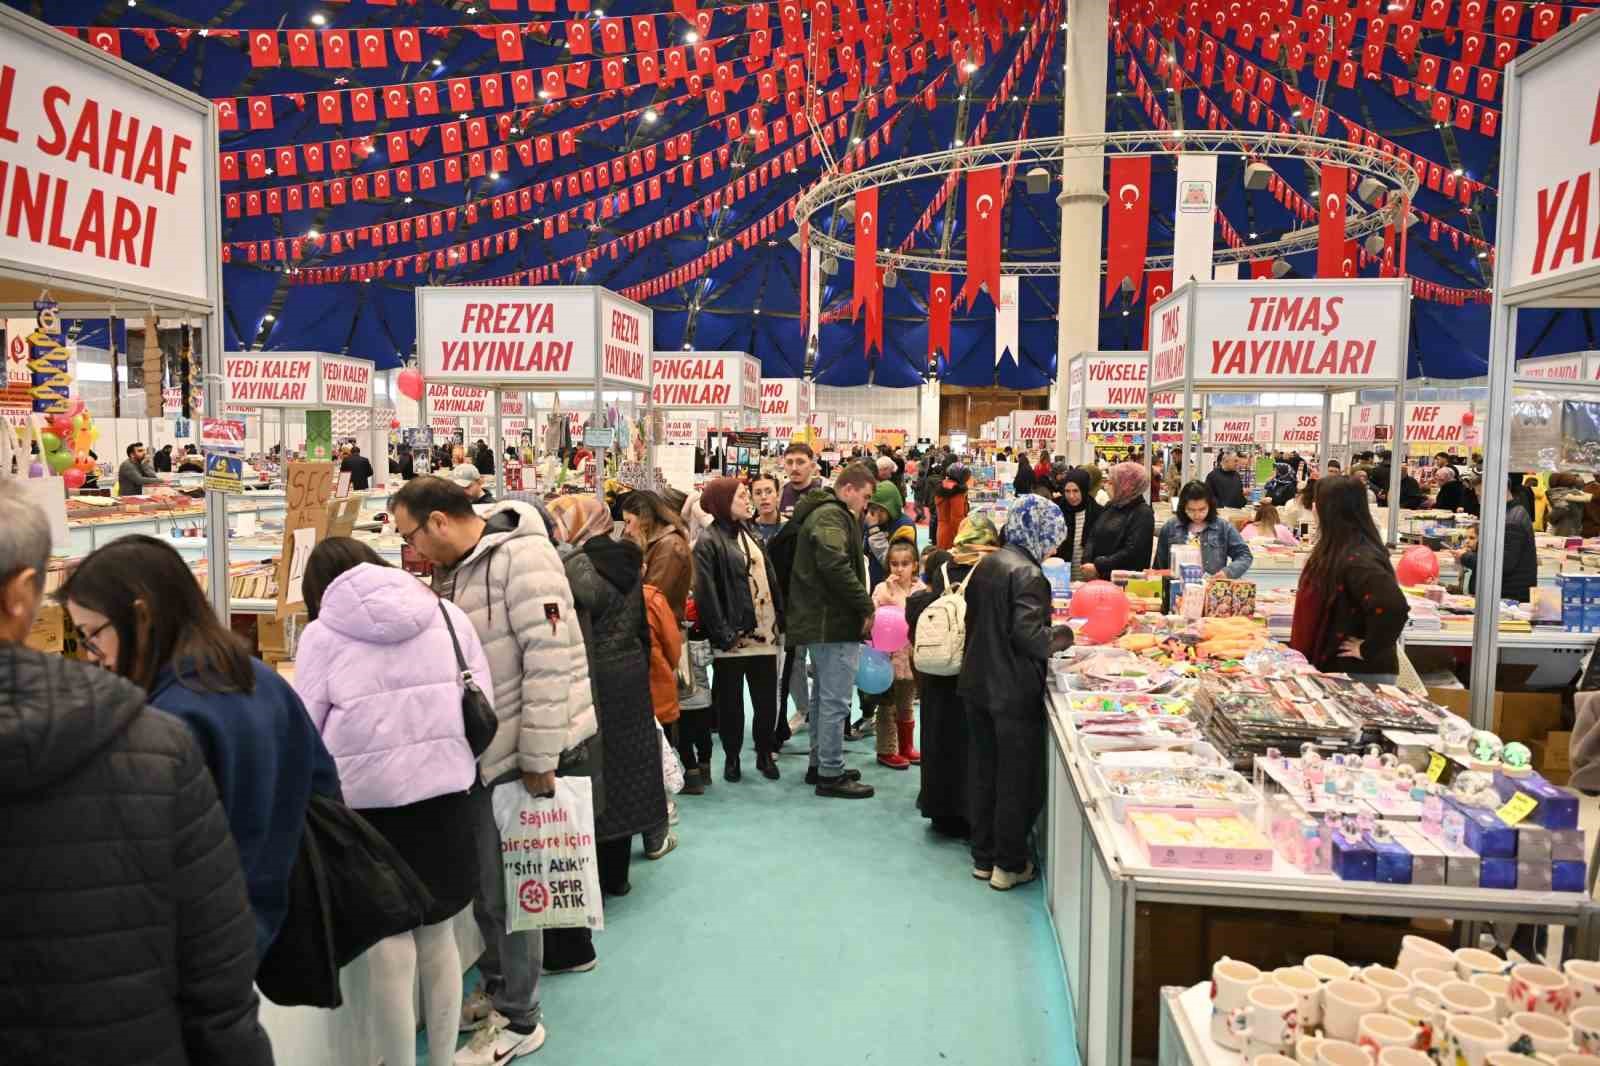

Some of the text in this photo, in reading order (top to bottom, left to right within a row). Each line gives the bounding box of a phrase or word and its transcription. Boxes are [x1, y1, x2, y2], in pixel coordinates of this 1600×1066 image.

[37, 86, 192, 195] SAHAF
[461, 303, 554, 334] FREZYA
[611, 309, 639, 345] FREZYA
[441, 341, 573, 372] YAYINLARI
[605, 343, 644, 380] YAYINLARI
[1211, 340, 1376, 374] YAYINLARI
[261, 360, 311, 379] KALEM
[343, 364, 369, 385] KALEM
[231, 382, 306, 401] YAYINLARI
[326, 383, 367, 405] YAYINLARI
[428, 385, 449, 397] ADA
[1108, 387, 1176, 405] YAYINARI
[433, 398, 485, 412] YAYINLARI
[1411, 406, 1441, 422] NEF
[1223, 421, 1250, 431] MARTI
[1297, 416, 1318, 427] SDS
[519, 807, 568, 828] Sağlıklı
[564, 832, 592, 851] için
[549, 879, 583, 894] SIFIR
[552, 893, 586, 910] ATIK
